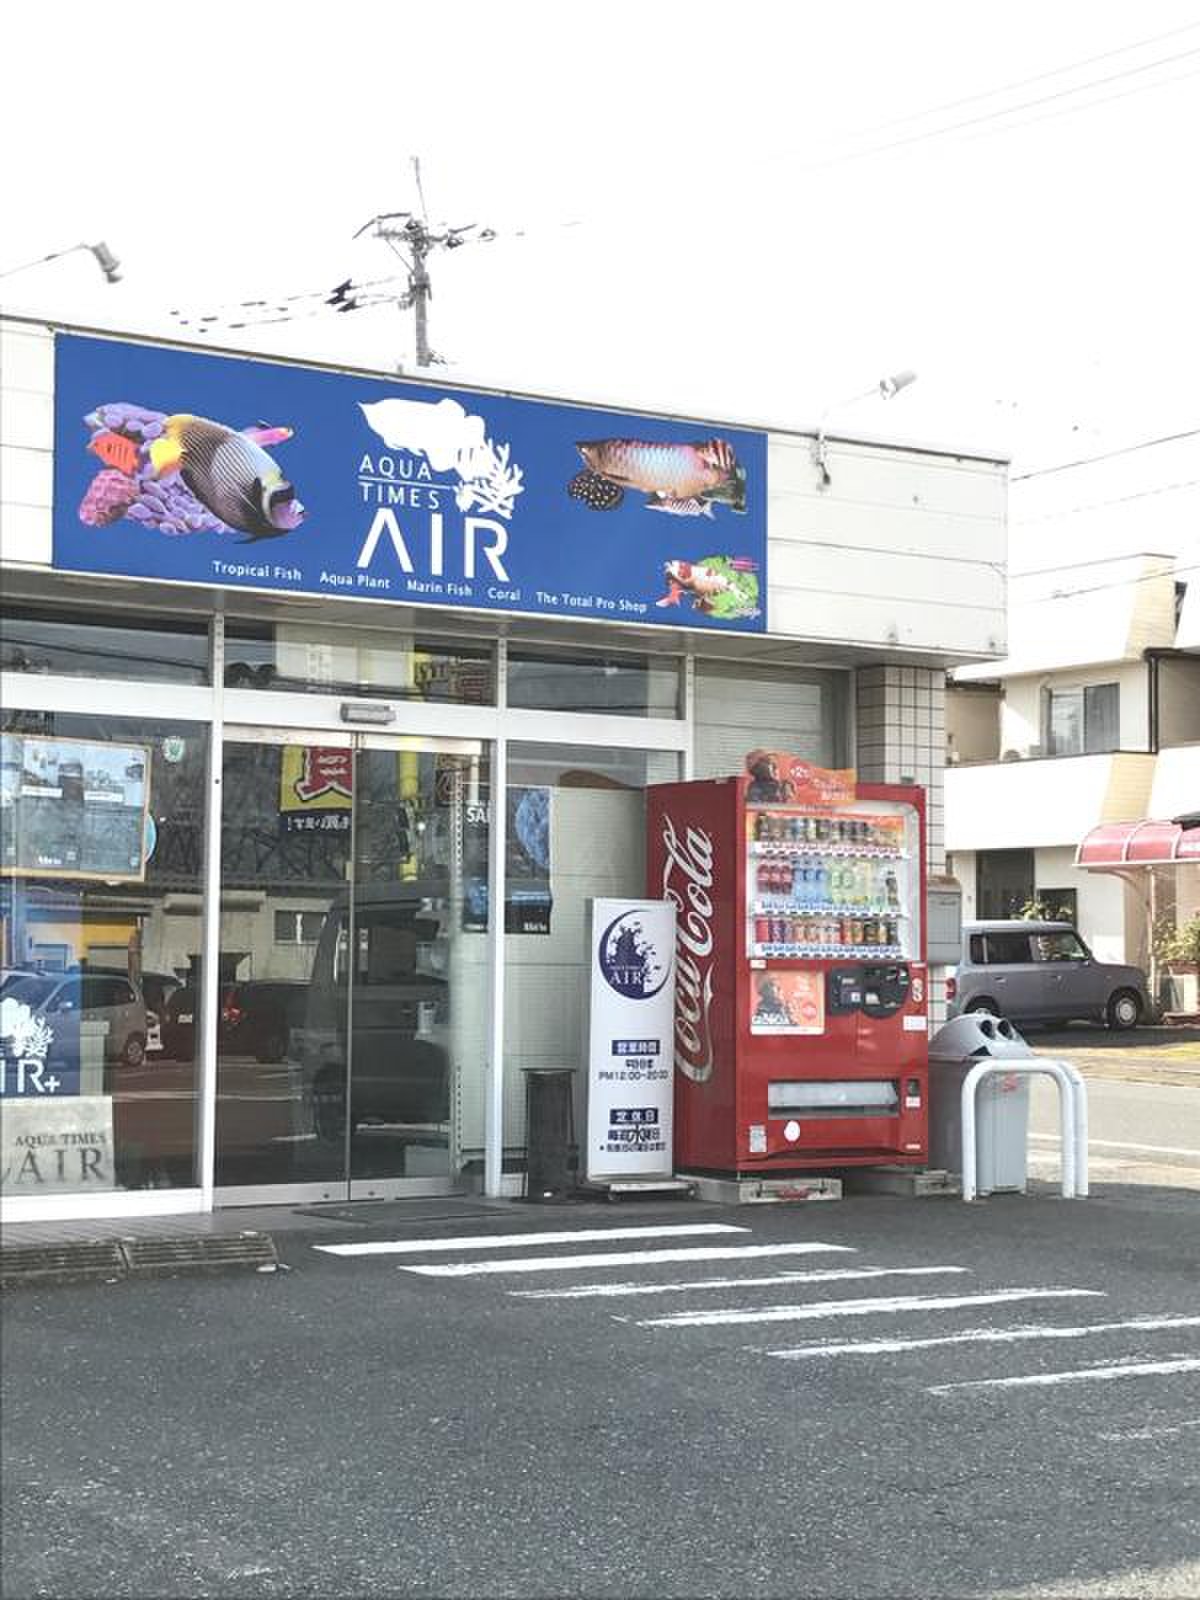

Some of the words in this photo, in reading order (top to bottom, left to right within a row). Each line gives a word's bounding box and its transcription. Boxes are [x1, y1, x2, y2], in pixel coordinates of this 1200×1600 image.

[359, 454, 432, 480] AQUA
[358, 482, 440, 509] TIMES
[357, 508, 510, 582] AIR
[212, 560, 270, 578] Tropical
[274, 566, 302, 581] Fish
[320, 571, 353, 586] Aqua
[357, 573, 390, 589] Plant
[407, 579, 443, 593] Marin
[447, 583, 473, 597] Fish
[487, 587, 521, 601] Coral
[536, 591, 558, 605] The
[562, 593, 592, 608] Total
[598, 597, 615, 609] Pro
[619, 598, 647, 614] Shop
[609, 970, 642, 985] AIR
[20, 1147, 105, 1183] AIR
